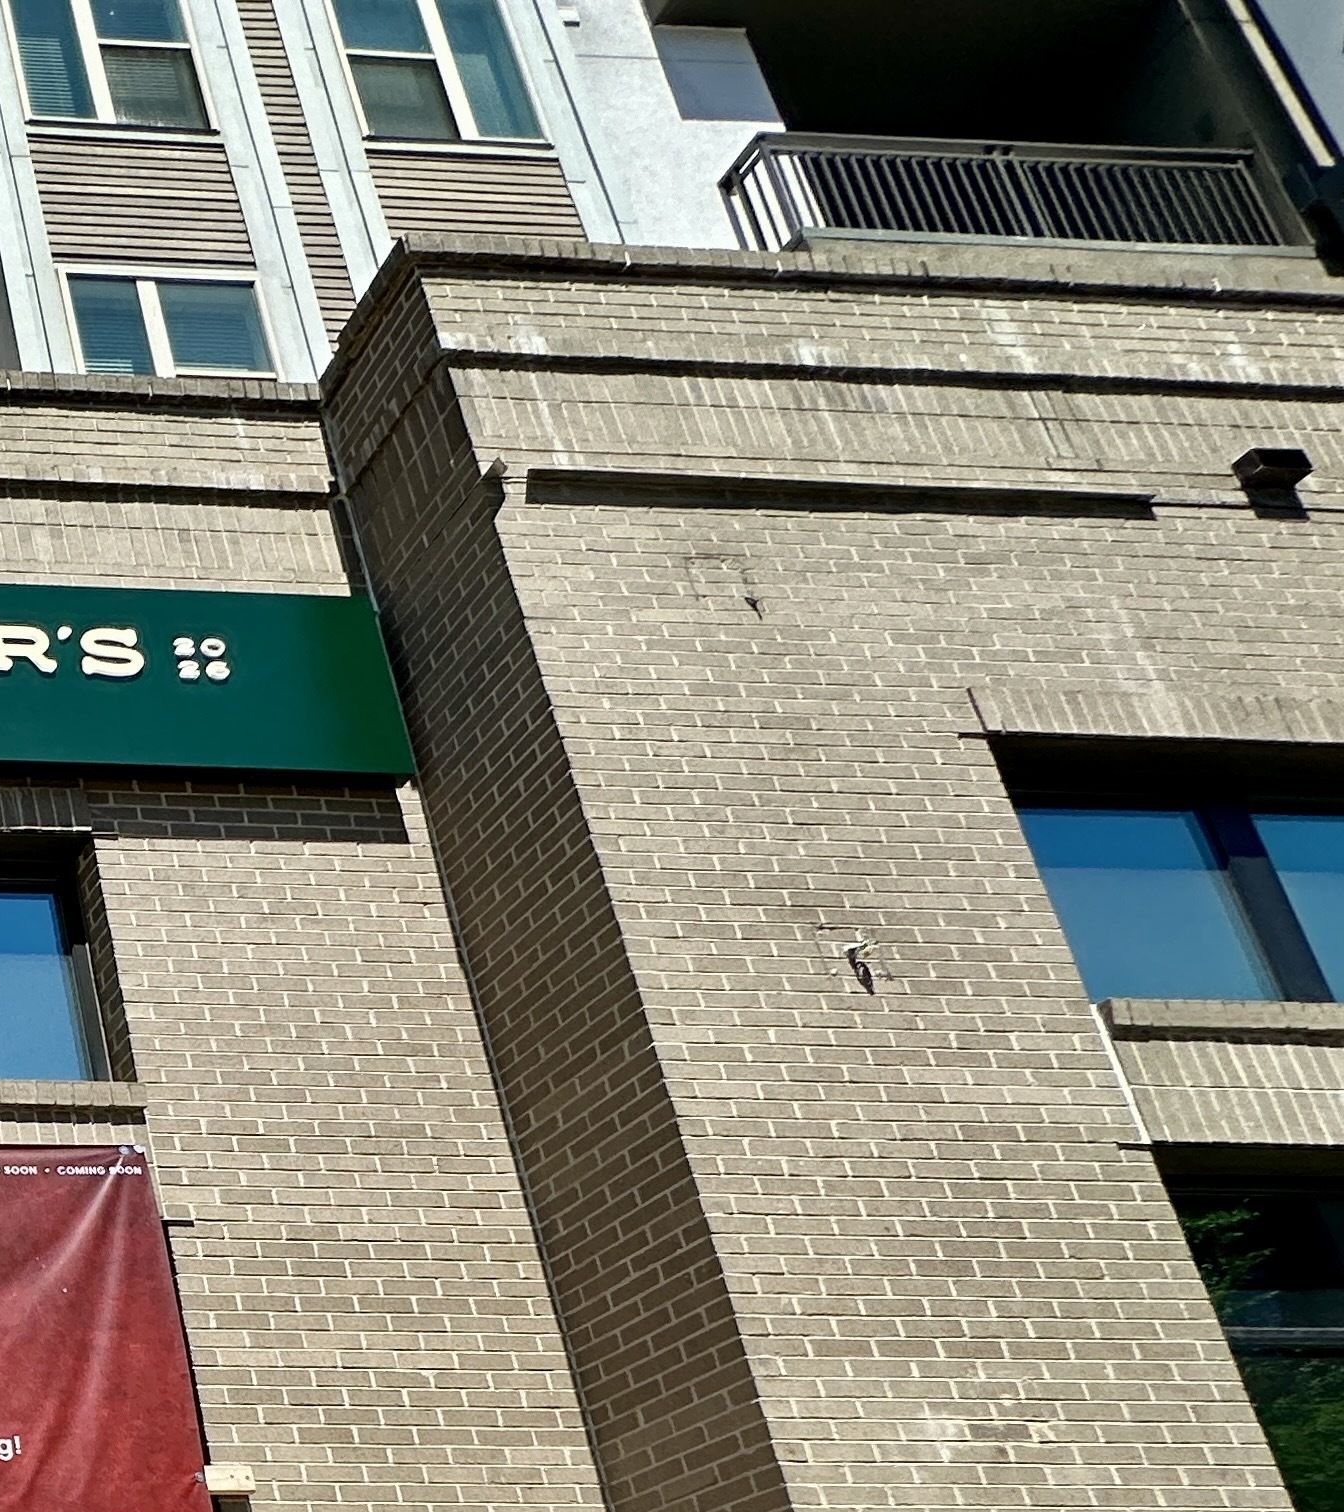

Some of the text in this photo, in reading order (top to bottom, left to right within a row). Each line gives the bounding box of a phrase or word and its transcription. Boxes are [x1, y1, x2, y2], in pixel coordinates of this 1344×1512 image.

[173, 637, 226, 657] 20
[3, 1165, 38, 1175] SOON
[56, 1165, 106, 1175] COMING
[108, 1165, 143, 1176] SOON
